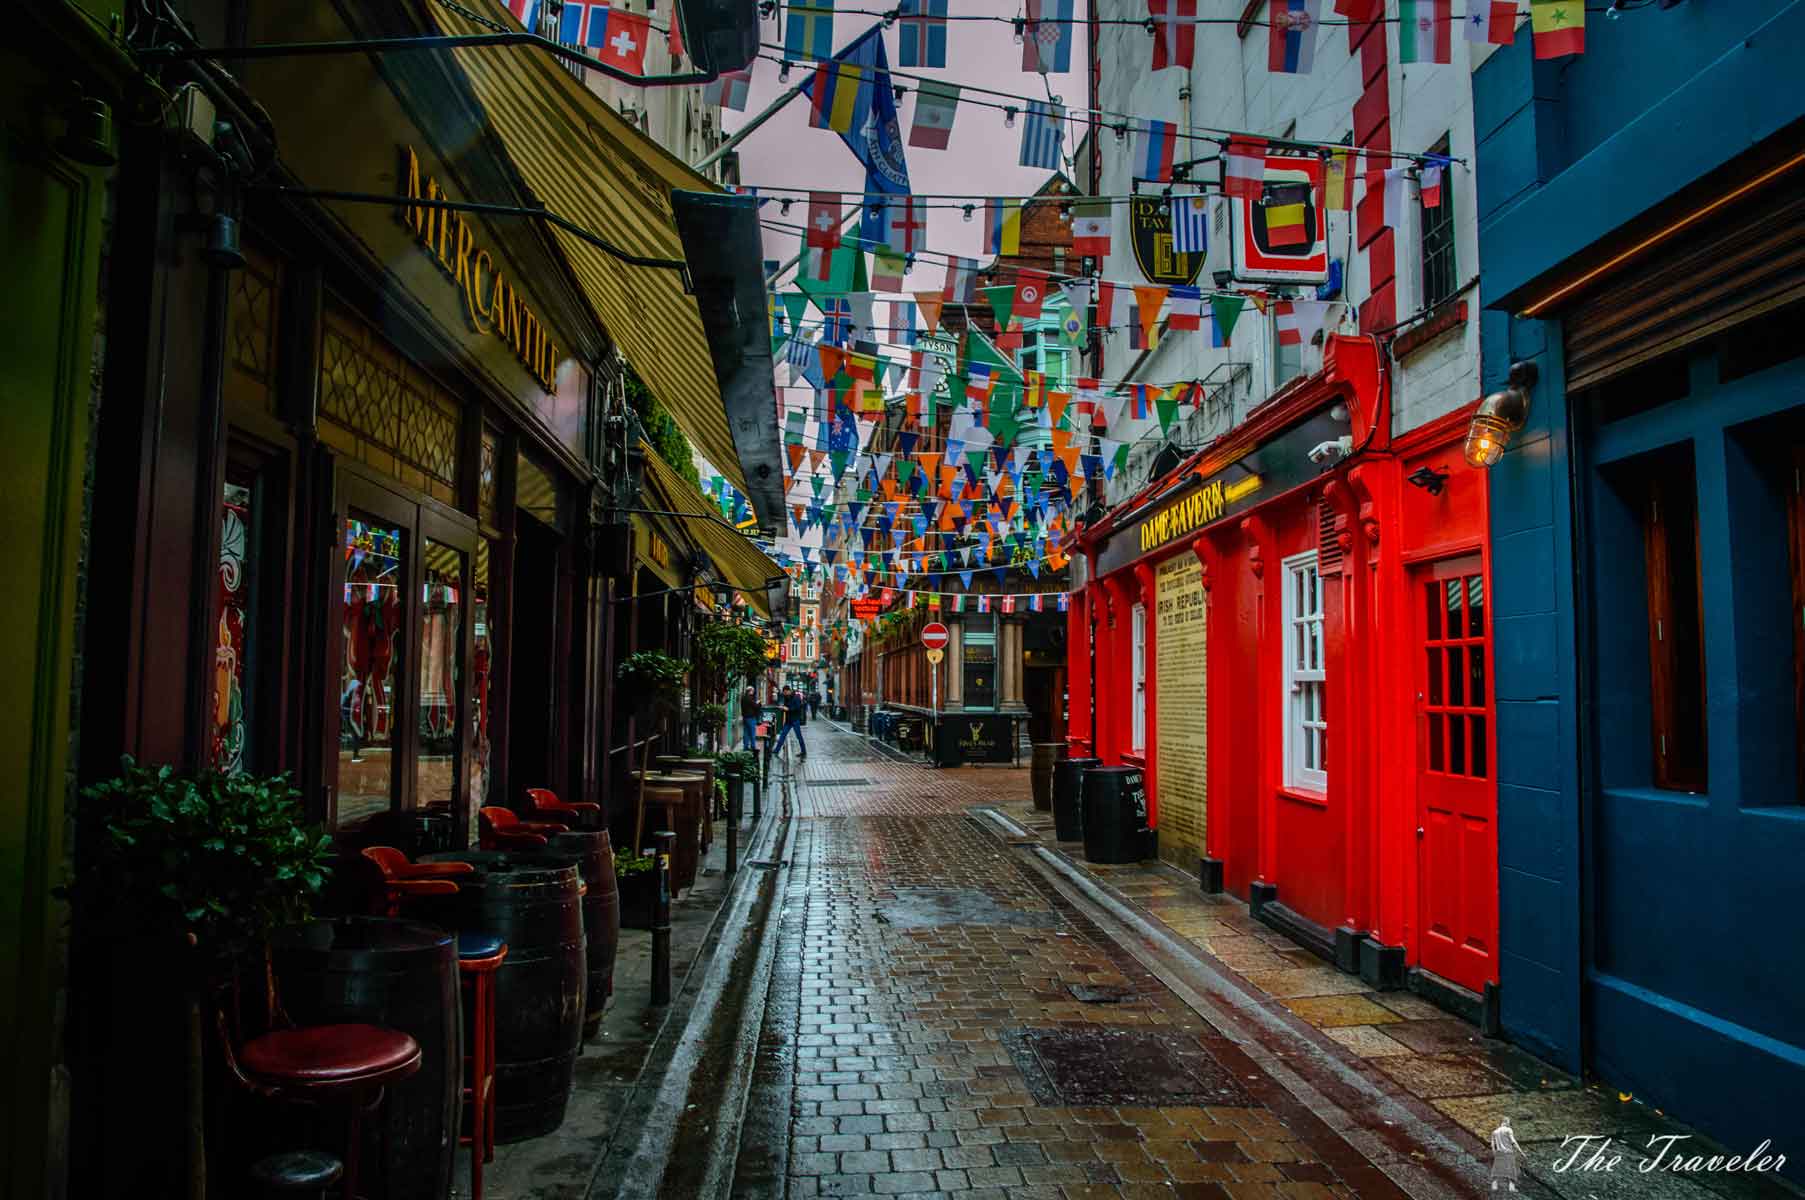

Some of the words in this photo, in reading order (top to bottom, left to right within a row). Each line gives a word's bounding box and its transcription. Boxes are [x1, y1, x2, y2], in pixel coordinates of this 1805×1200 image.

[405, 145, 559, 397] MERCANTILE
[1141, 509, 1170, 552] DAME
[1170, 479, 1225, 538] TAVERN
